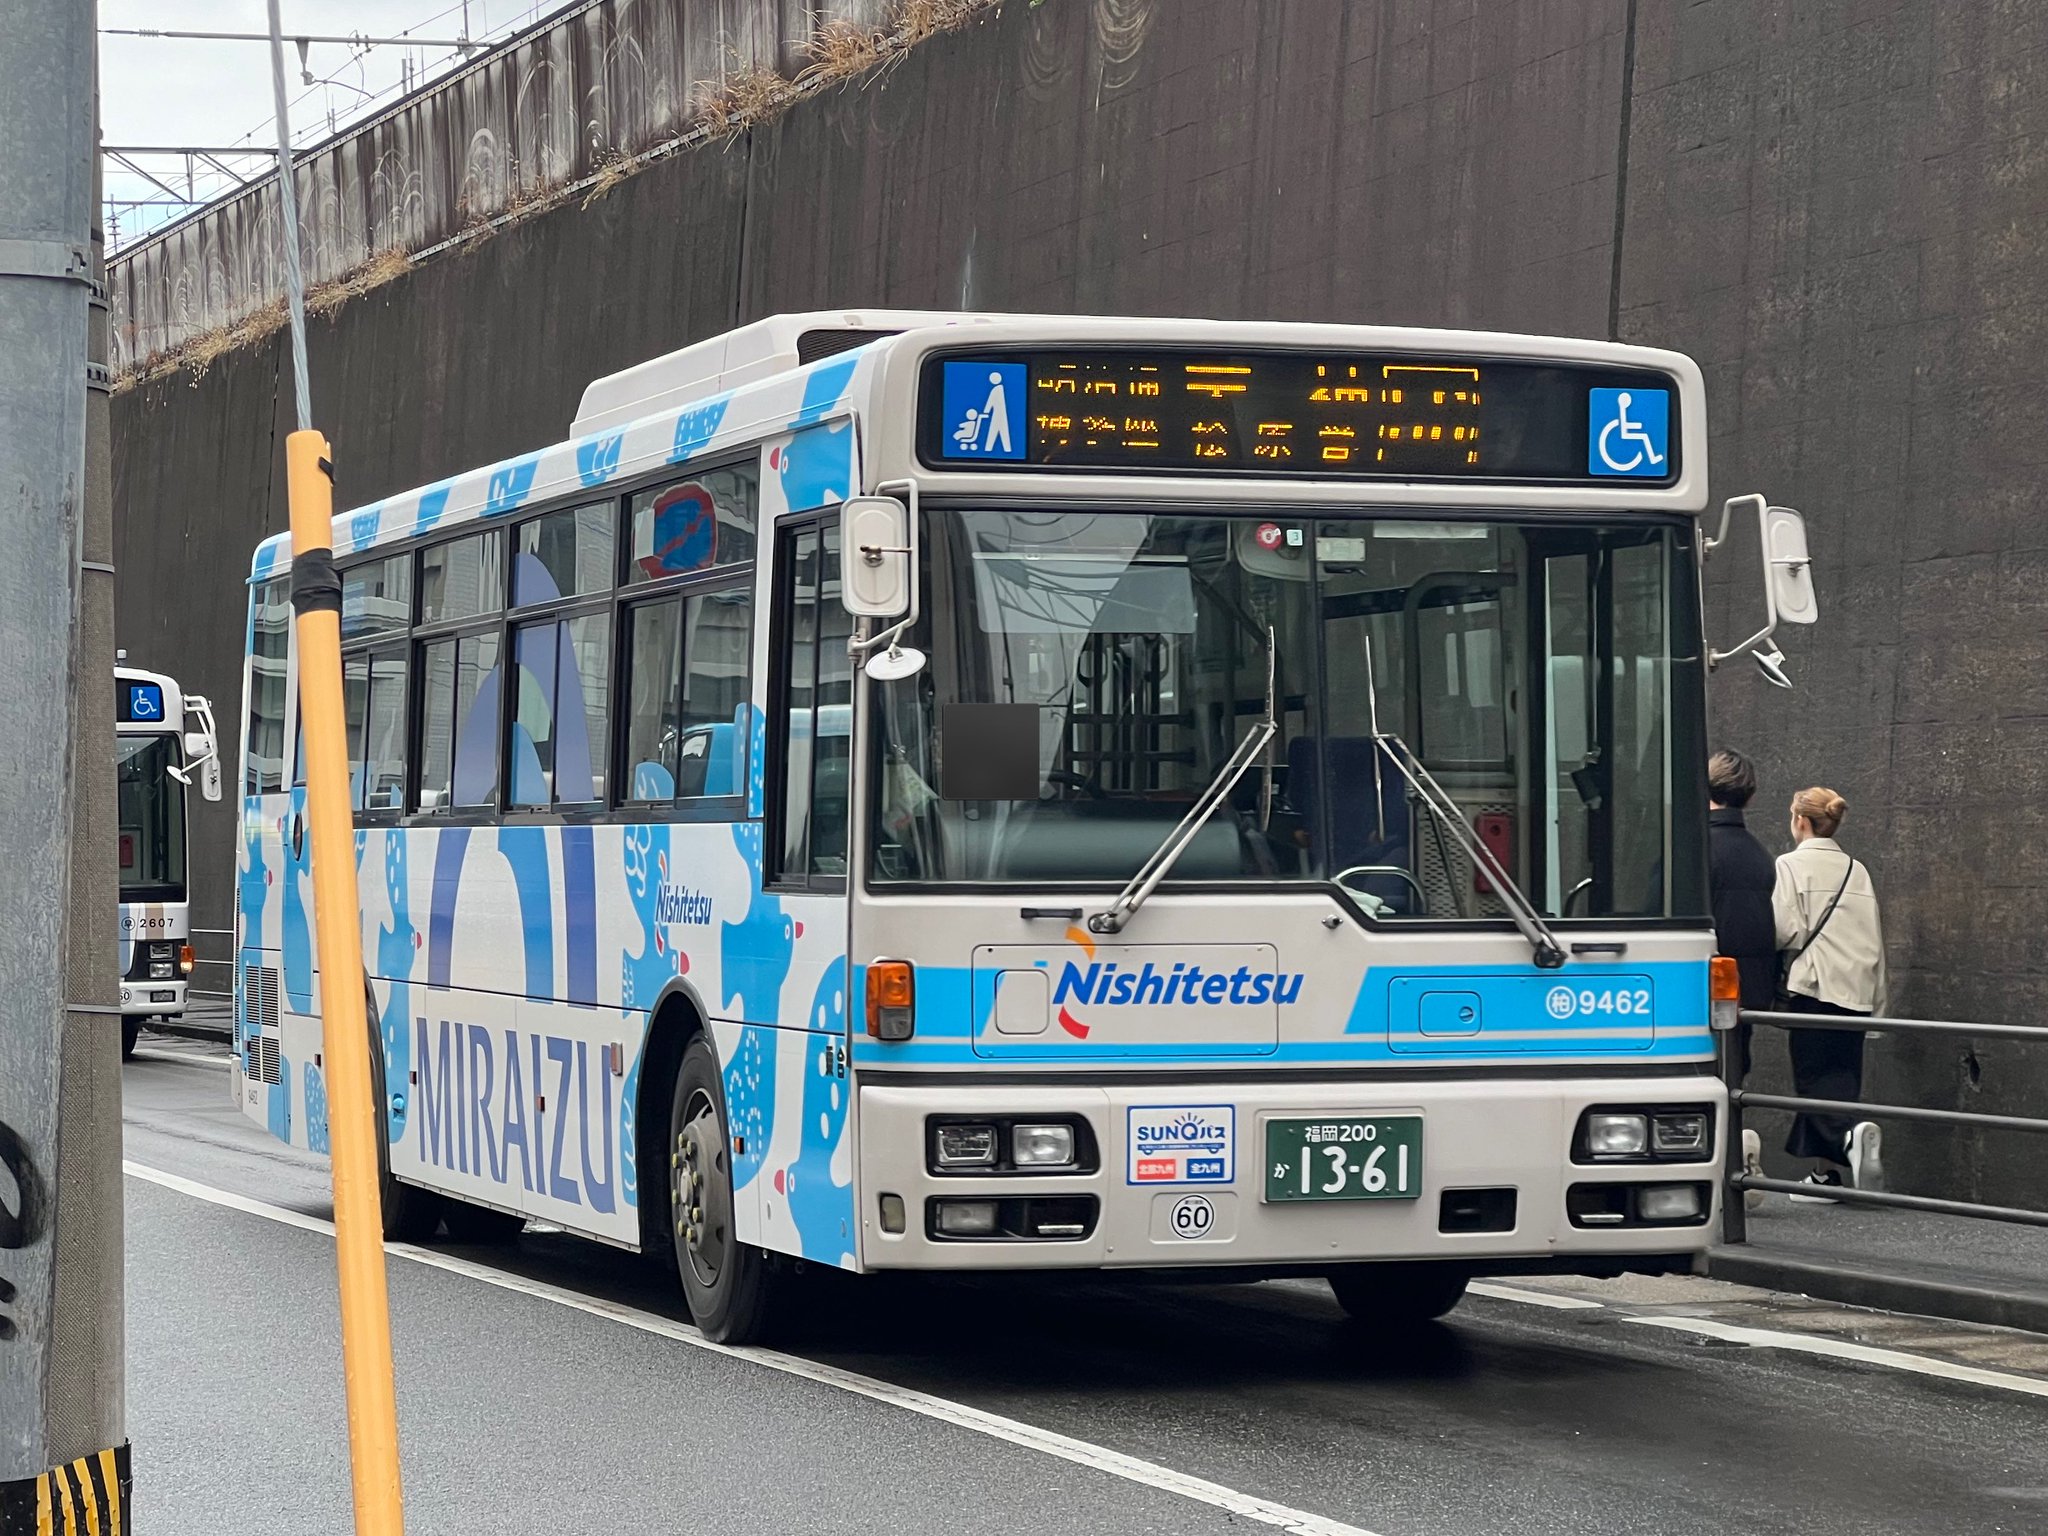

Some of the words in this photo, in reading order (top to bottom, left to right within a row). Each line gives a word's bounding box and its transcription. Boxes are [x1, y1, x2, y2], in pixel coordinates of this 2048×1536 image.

[140, 918, 174, 928] 2607
[655, 884, 713, 925] Nishitetsu
[1052, 961, 1304, 1005] Nishitetsu
[1579, 990, 1650, 1015] 9462
[416, 1017, 617, 1214] MIRAIZU
[1273, 1163, 1291, 1179] か
[1301, 1144, 1408, 1194] 13-61
[1177, 1206, 1209, 1229] 60
